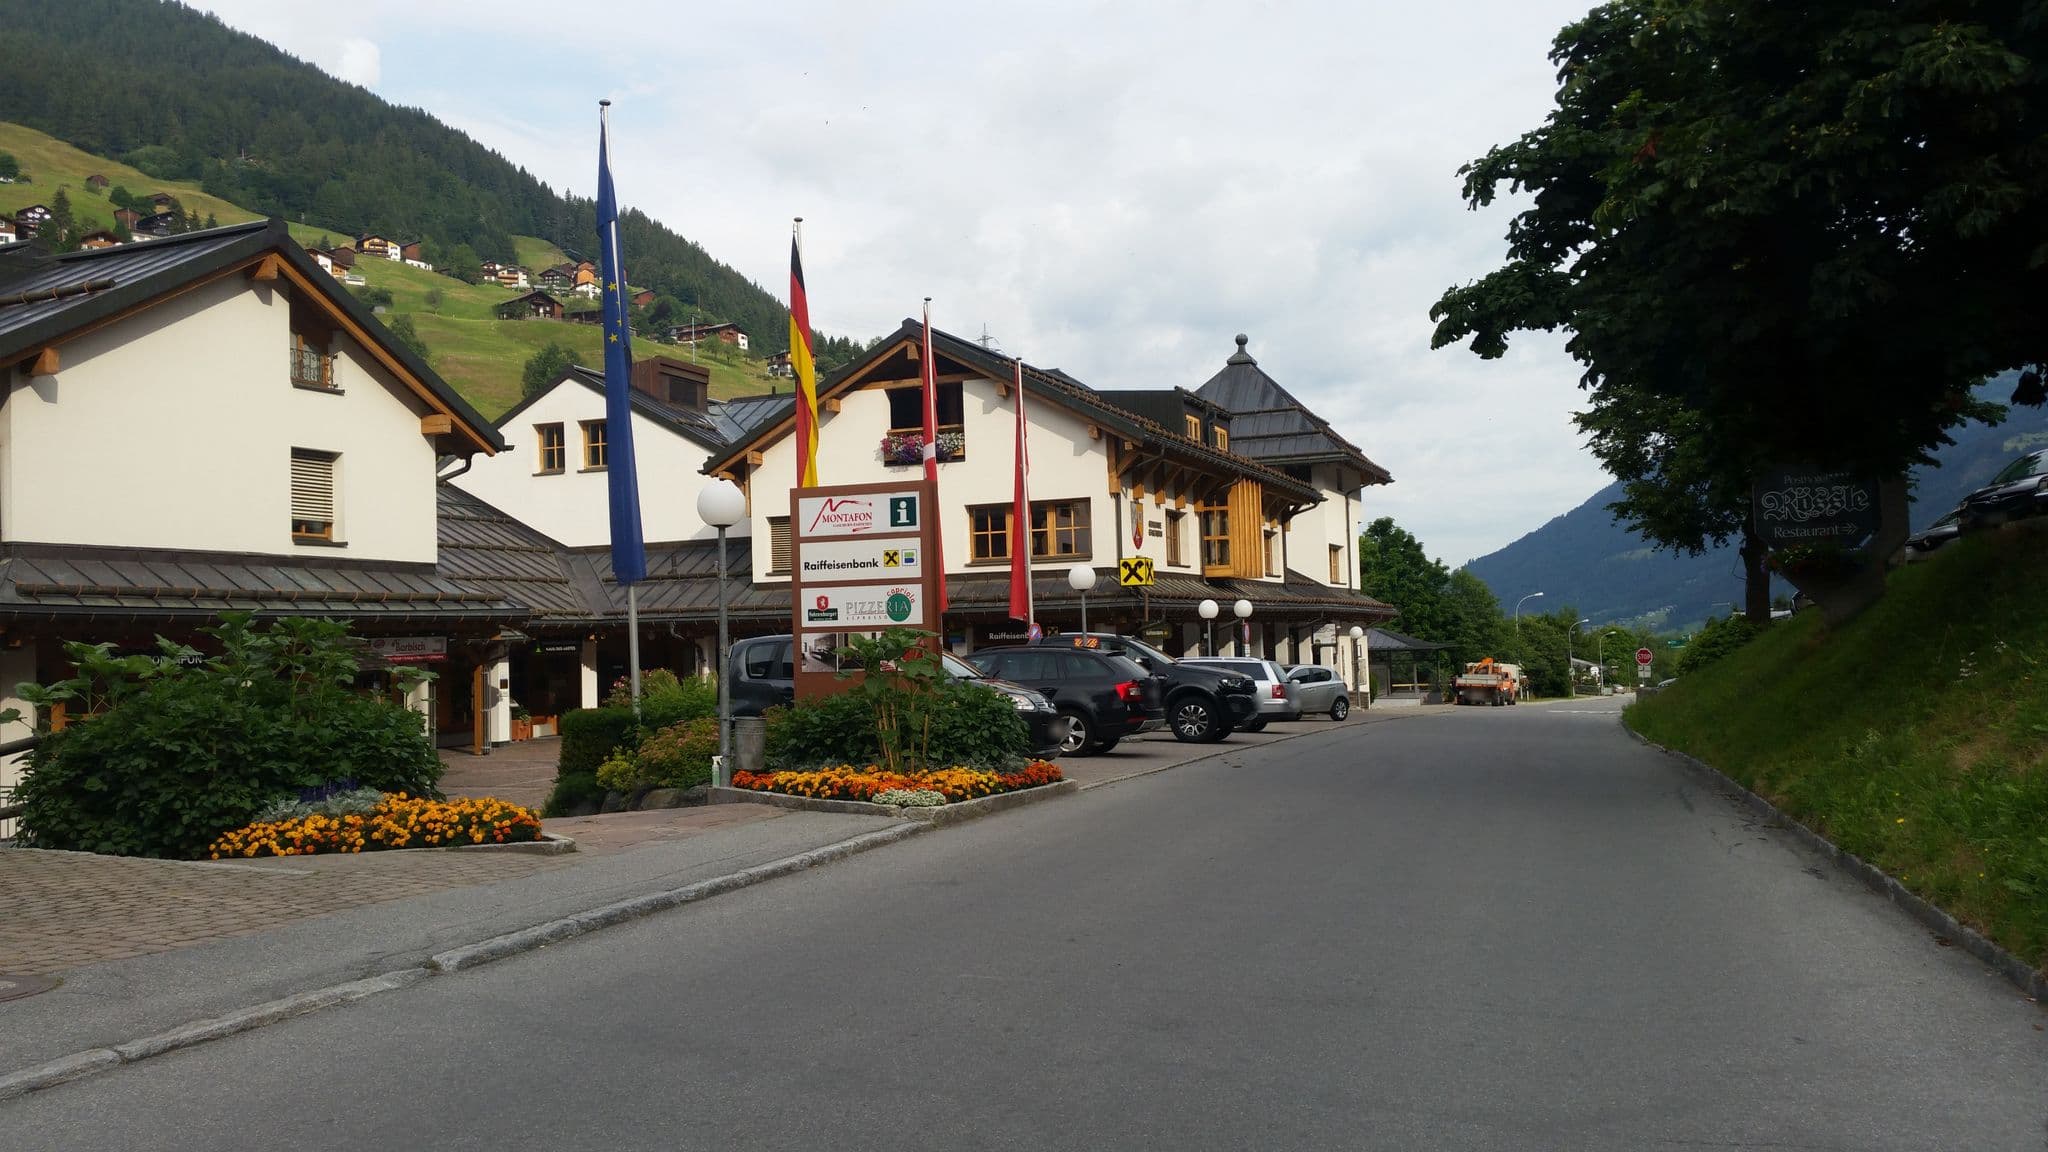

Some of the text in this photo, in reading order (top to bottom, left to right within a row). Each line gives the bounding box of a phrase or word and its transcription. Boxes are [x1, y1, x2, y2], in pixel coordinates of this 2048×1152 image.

[822, 511, 872, 523] MONTAFON
[1774, 526, 1838, 539] Restaurant
[803, 558, 879, 571] Raiffeisenbank
[845, 600, 909, 615] PIZZERIA
[1637, 653, 1651, 661] STOP
